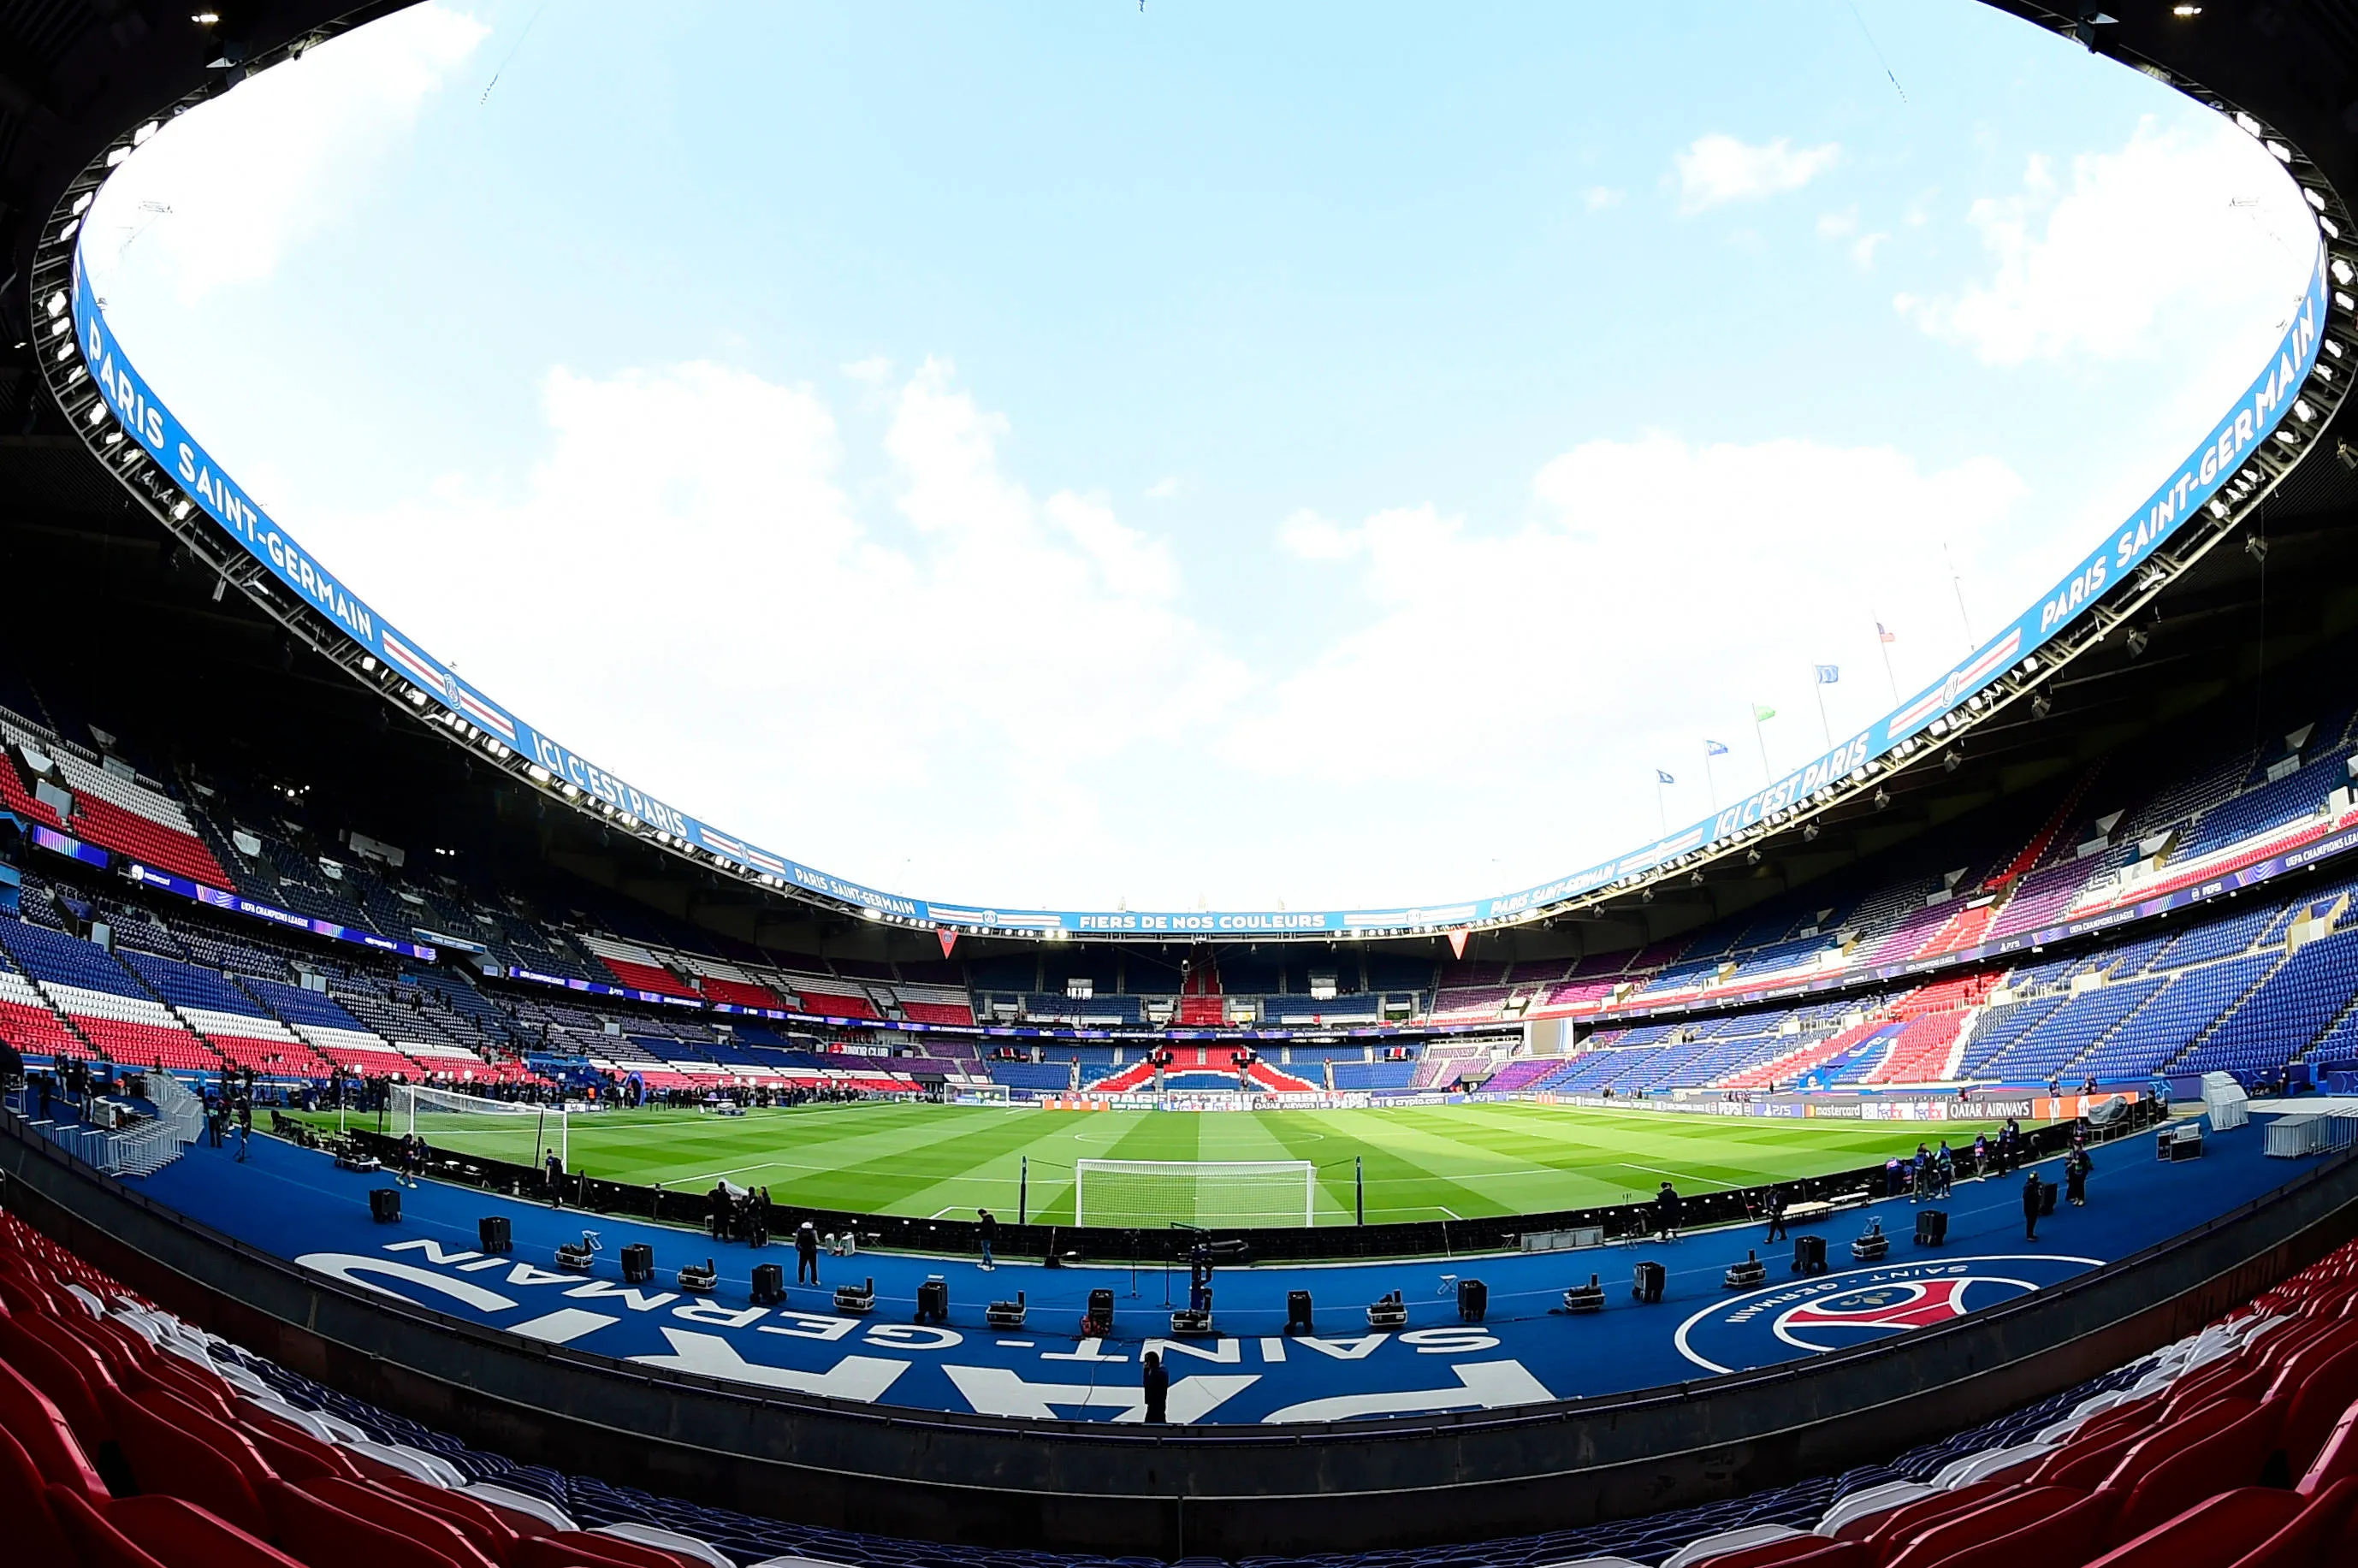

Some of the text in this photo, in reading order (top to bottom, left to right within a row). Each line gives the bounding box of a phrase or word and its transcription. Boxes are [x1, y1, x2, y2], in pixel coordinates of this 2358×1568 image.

[2040, 297, 2315, 634] PARIS SAINT-GERMAIN
[88, 315, 375, 643] PARIS SAINT-GERMAIN
[531, 731, 689, 838] ICI C'EST PARIS
[1714, 731, 1869, 838] ICI C'EST PARIS
[2285, 854, 2303, 867] UEFA
[2303, 837, 2344, 861] CHAMPIONS
[794, 867, 916, 916] PARIS SAINT-GERMAIN
[1490, 862, 1616, 915] PARIS SAINT-GERMAIN
[1080, 914, 1325, 929] FIERS DE NOS COULEURS
[839, 1044, 889, 1058] JUNIOR CLUB
[1254, 1101, 1315, 1110] QATAR AIRWAYS
[1333, 1098, 1369, 1109] PEPSI
[1395, 1097, 1444, 1107] crypto.com
[1718, 1102, 1743, 1115] PEPSI
[1773, 1104, 1792, 1115] PS5
[1815, 1104, 1861, 1117] mastercard
[1950, 1101, 2029, 1118] QATAR AIRWAYS
[1724, 1263, 1970, 1325] SAINT GERMAIN
